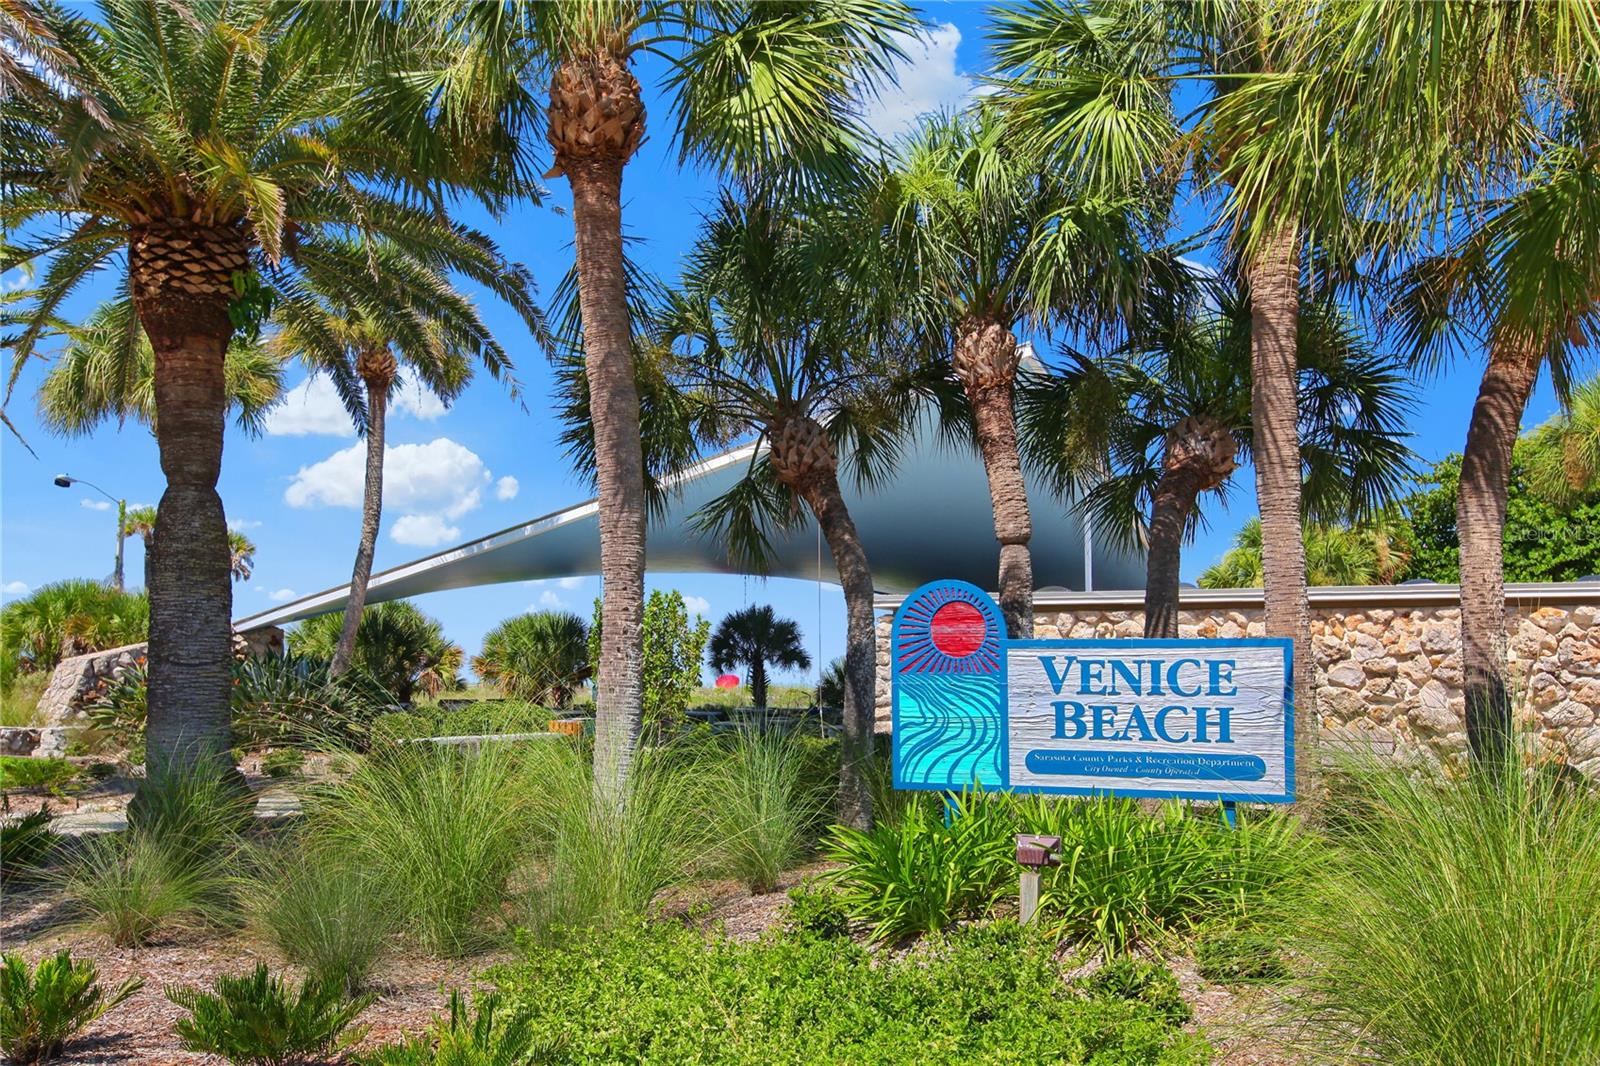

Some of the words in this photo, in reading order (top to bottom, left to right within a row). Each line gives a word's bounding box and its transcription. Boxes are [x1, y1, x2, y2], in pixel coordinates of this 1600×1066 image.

[1037, 655, 1238, 698] VENICE
[1050, 700, 1235, 744] BEACH
[1034, 752, 1071, 762] Sarasota
[1072, 753, 1105, 764] County
[1107, 754, 1133, 764] Parks
[1135, 755, 1143, 764] &
[1145, 755, 1195, 766] Recreation
[1197, 757, 1256, 768] Department
[1084, 764, 1101, 774] City
[1101, 764, 1129, 774] Owned
[1135, 765, 1162, 775] County
[1164, 766, 1201, 776] Operated
